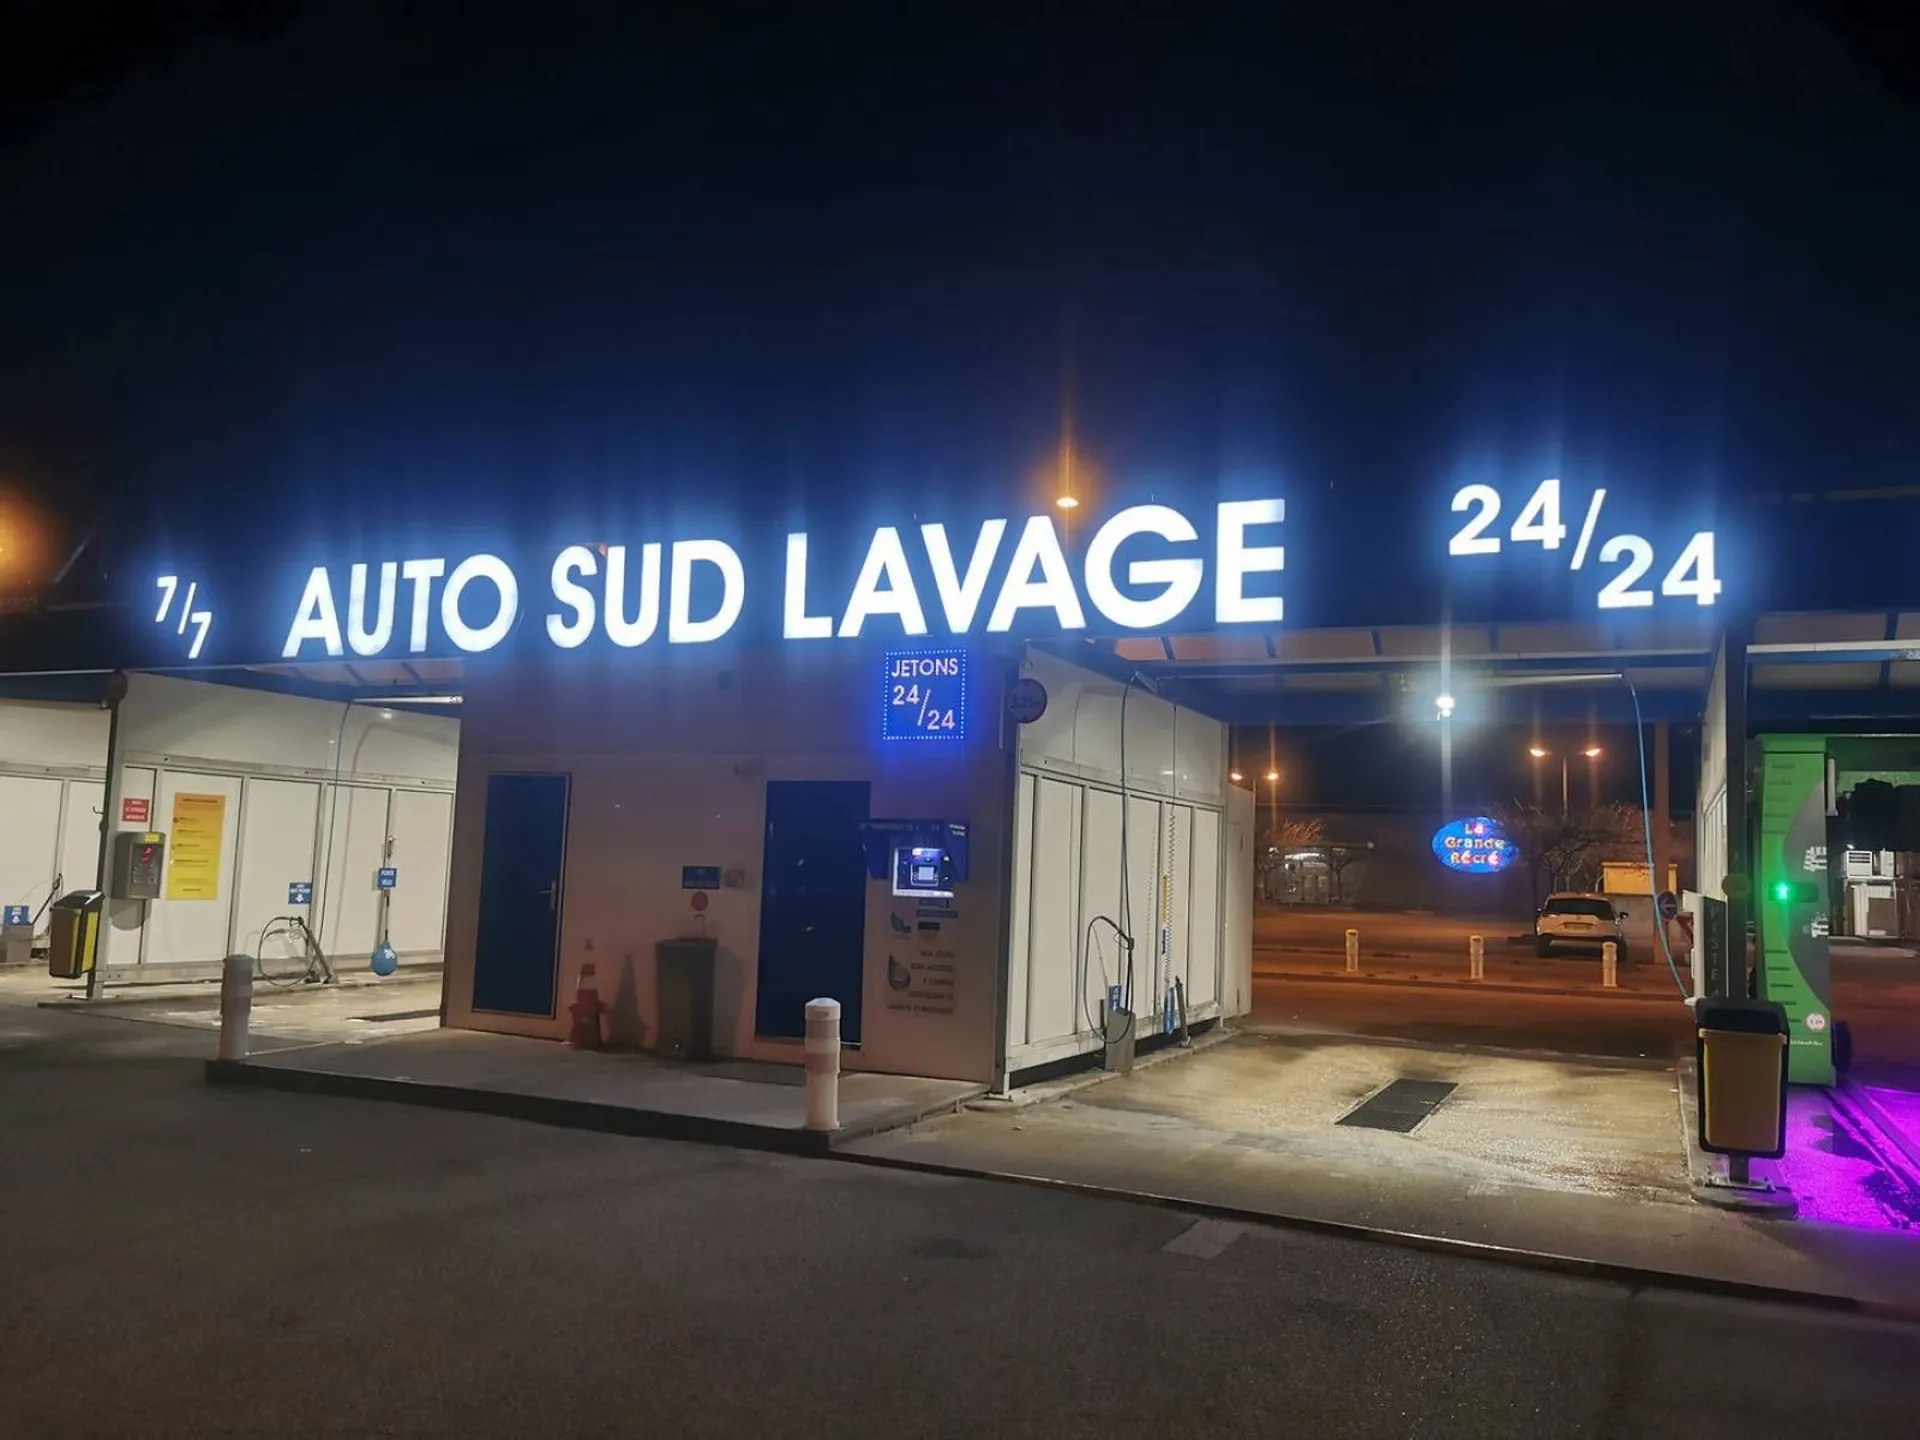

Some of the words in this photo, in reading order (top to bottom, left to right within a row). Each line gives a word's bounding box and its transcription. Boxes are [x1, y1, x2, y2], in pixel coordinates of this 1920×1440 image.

[281, 554, 518, 656] AUTO
[546, 539, 745, 649] SUD
[784, 499, 1285, 638] LAVAGE
[1449, 479, 1722, 609] 24/24
[155, 575, 211, 660] 7/7
[891, 658, 958, 677] JETONS
[892, 684, 955, 730] 24/24
